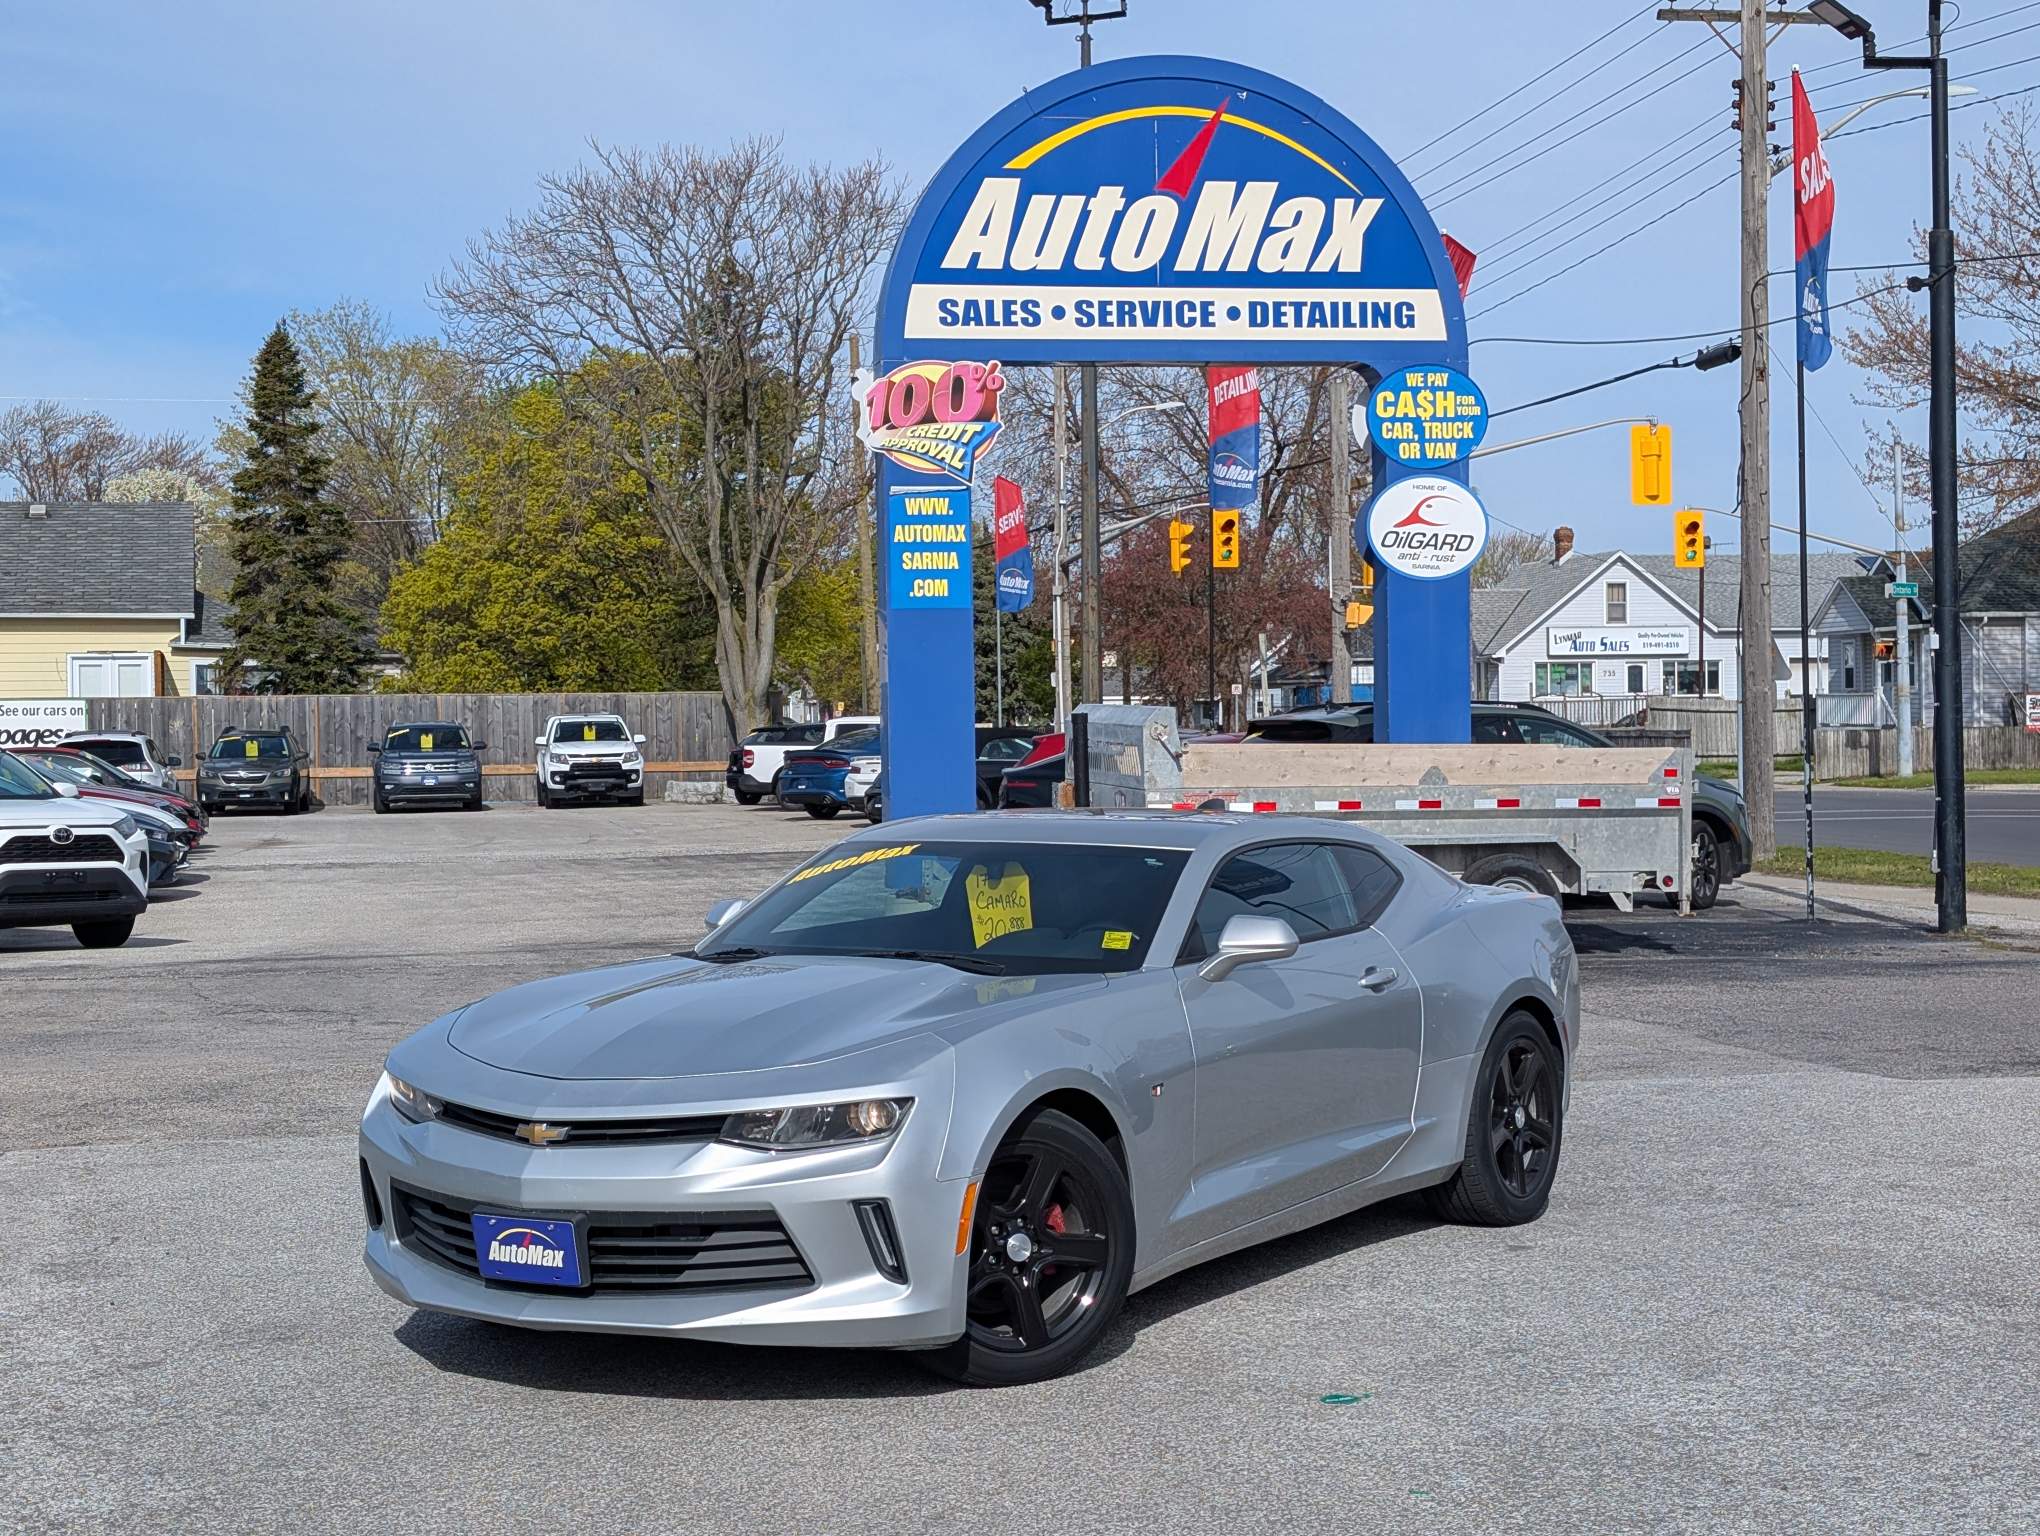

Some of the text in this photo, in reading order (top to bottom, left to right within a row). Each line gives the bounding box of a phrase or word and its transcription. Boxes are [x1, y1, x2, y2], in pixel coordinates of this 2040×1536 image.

[938, 299, 1416, 329] SALES SERVICE DETAILING
[1406, 373, 1449, 387] WE PAY
[866, 362, 1004, 432] 100%
[1376, 389, 1455, 420] CA$H
[1456, 396, 1475, 405] FOR
[1457, 406, 1481, 416] YOUR
[907, 424, 983, 444] CREDIT
[1382, 422, 1474, 441] CAR, TRUCK
[881, 437, 966, 470] APPROVAL
[1399, 442, 1457, 459] OR VAN
[904, 497, 954, 516] WWW.
[893, 524, 967, 543] AUTOMAX
[1380, 530, 1475, 552] OilGARD
[902, 552, 959, 570] SARNIA
[909, 578, 949, 597] .COM
[0, 704, 84, 716] See our cars on
[975, 890, 1027, 911] CAMARO
[488, 1240, 565, 1268] AutoMax
